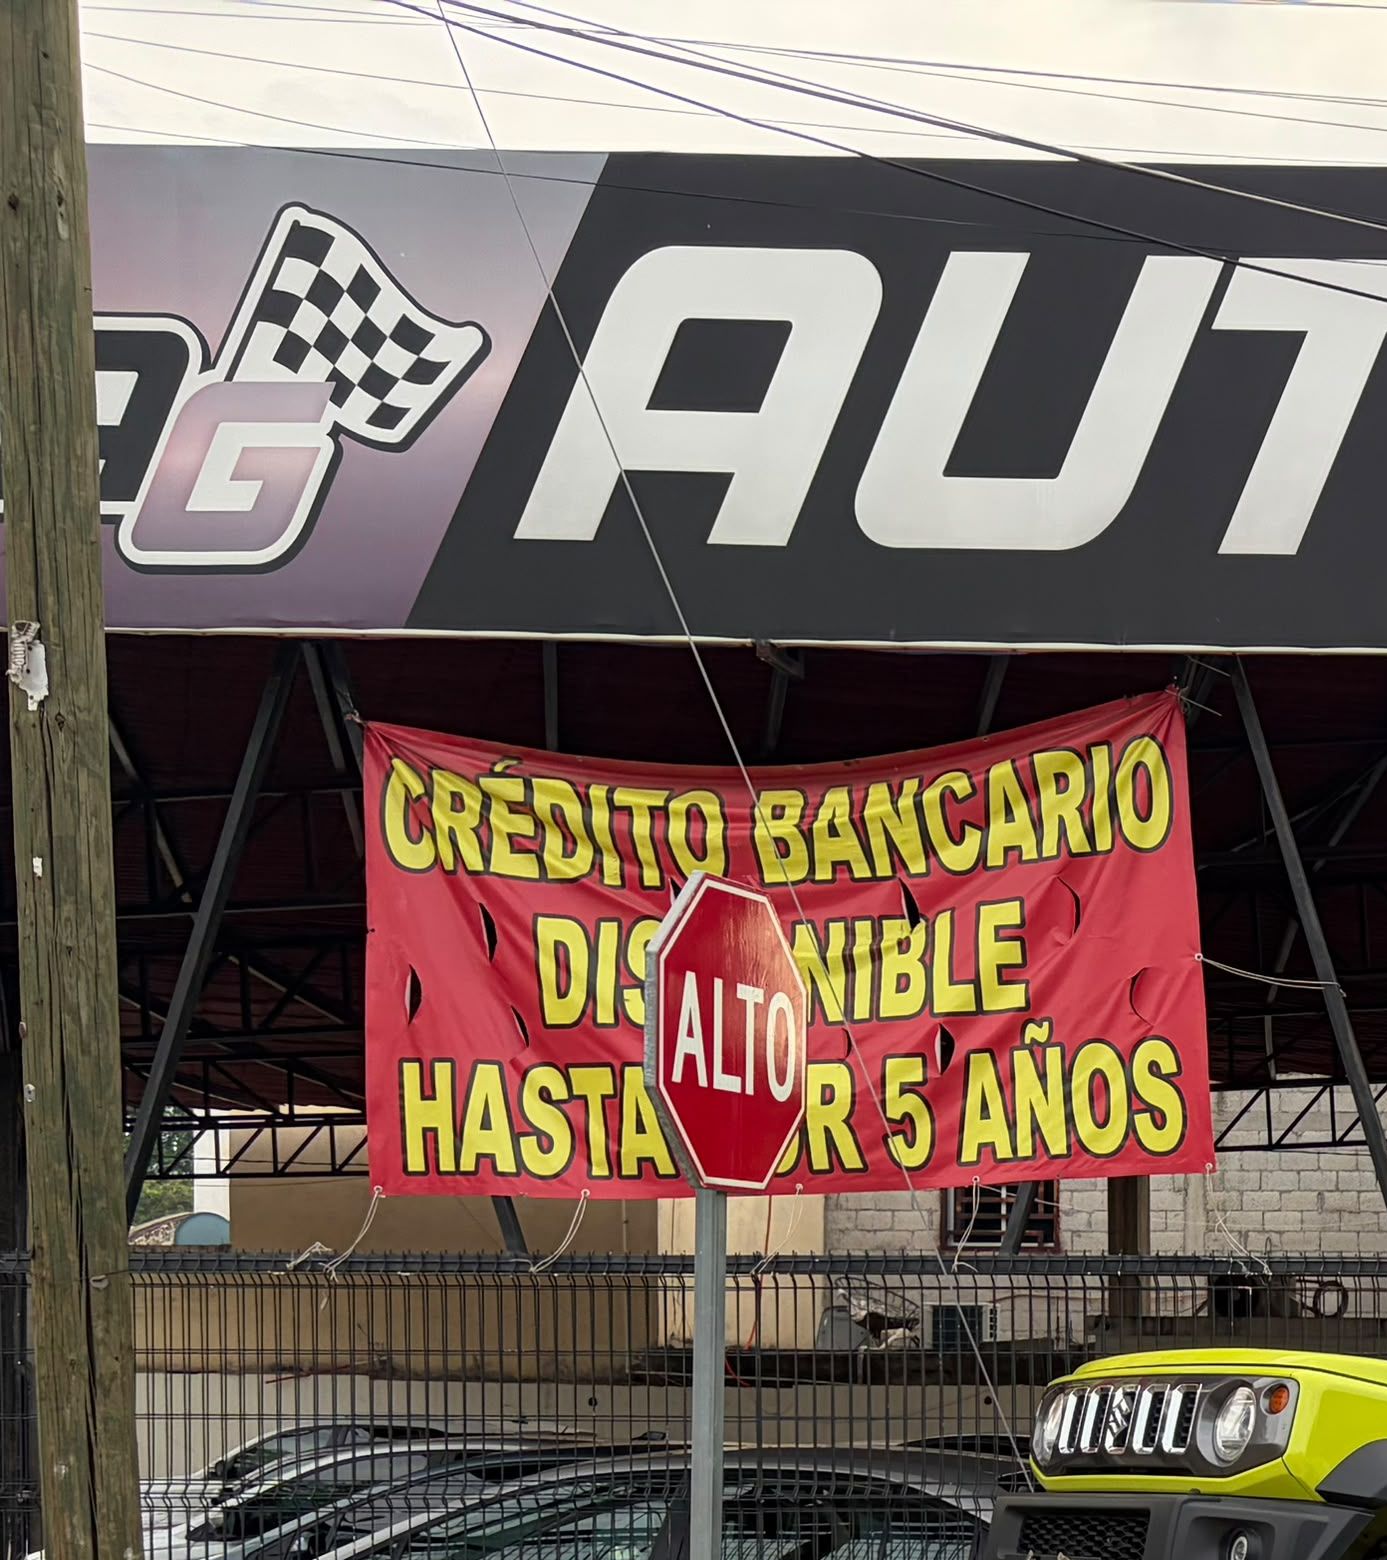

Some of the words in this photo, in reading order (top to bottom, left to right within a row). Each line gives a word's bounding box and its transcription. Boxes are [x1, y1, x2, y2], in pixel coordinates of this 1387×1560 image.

[382, 757, 729, 889] CRÉDITO
[753, 734, 1173, 886] BANCARIO
[533, 898, 1029, 1030] DINIBLE
[399, 1057, 681, 1180] HASTA
[881, 1055, 933, 1171] 5
[957, 1017, 1187, 1167] AÑOS
[671, 970, 796, 1103] ALTO
